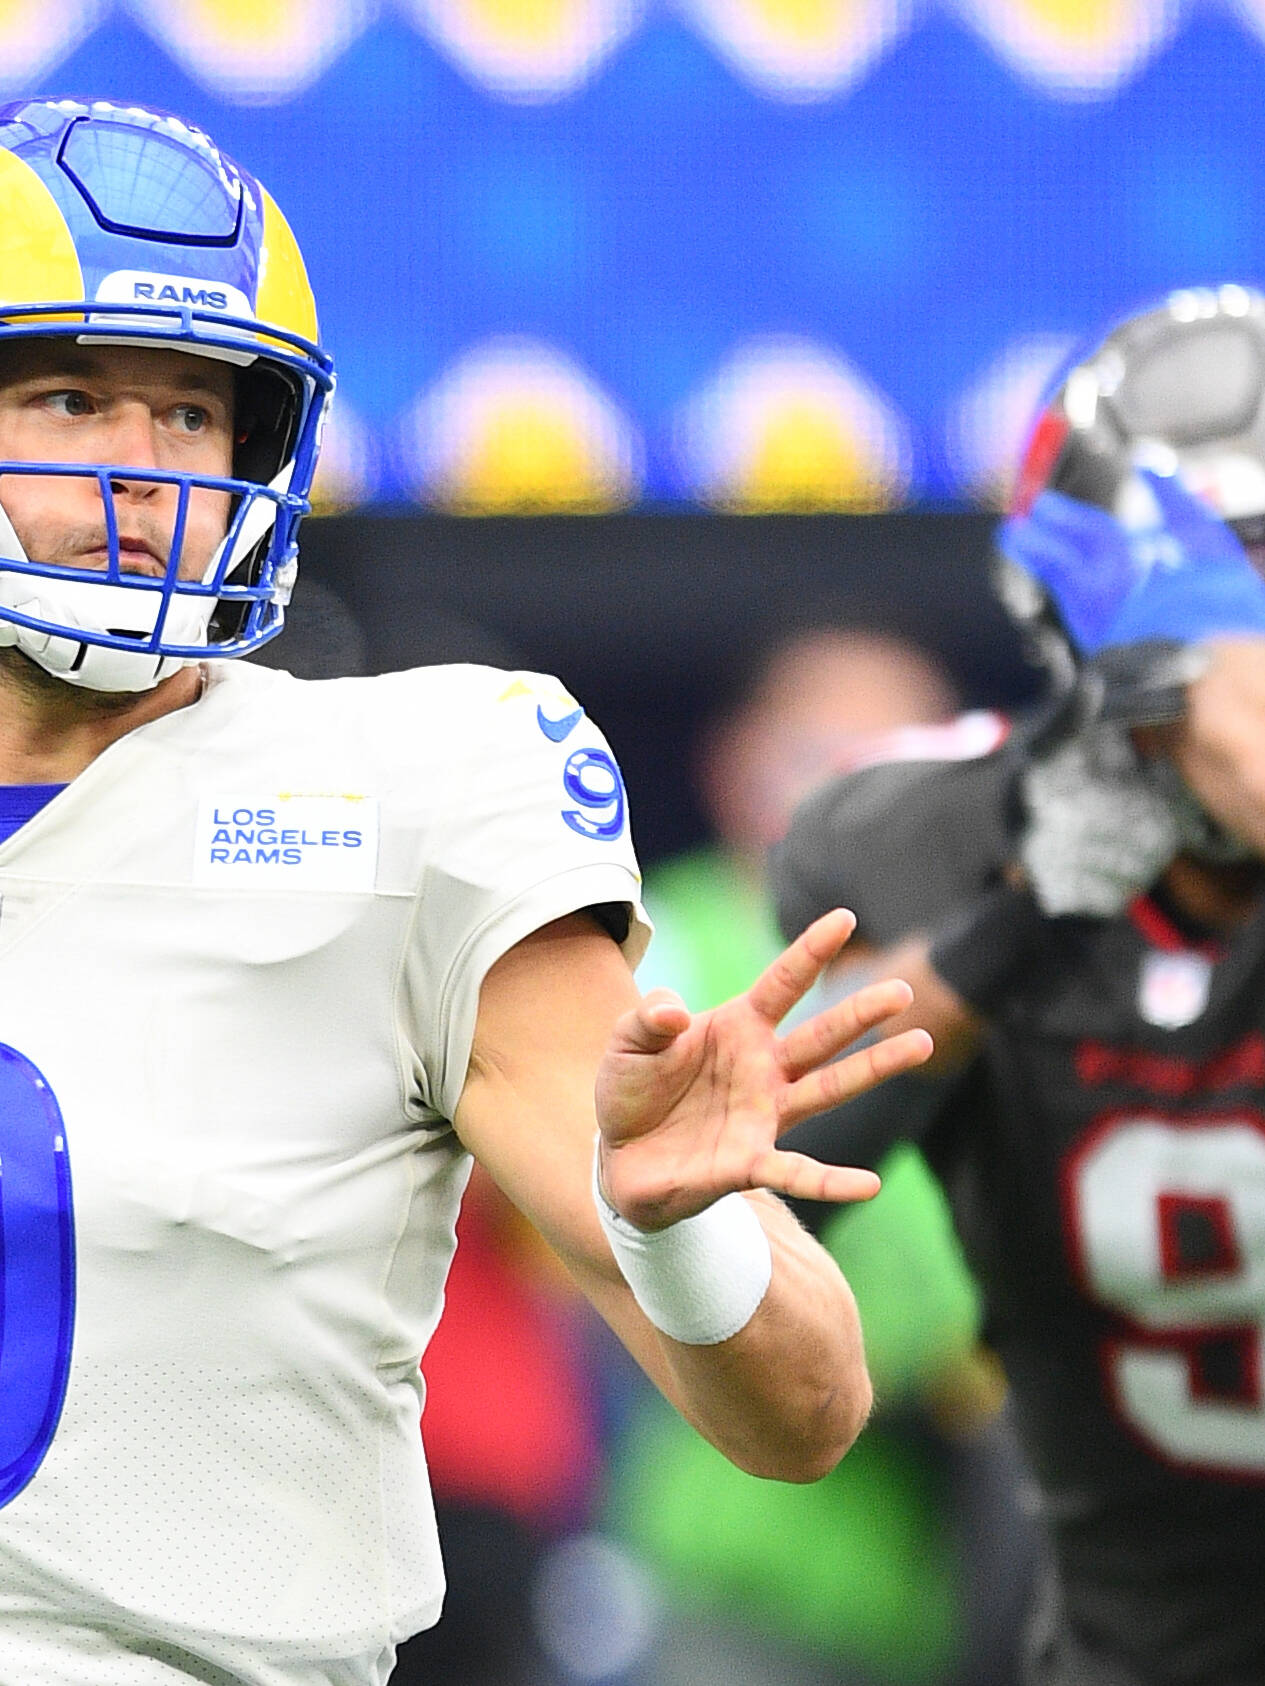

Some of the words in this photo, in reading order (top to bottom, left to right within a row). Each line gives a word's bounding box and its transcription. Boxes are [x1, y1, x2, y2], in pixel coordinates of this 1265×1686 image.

[134, 283, 228, 309] RAMS
[561, 748, 627, 842] 9
[213, 809, 275, 826] LOS
[211, 828, 362, 849] ANGELES
[210, 849, 302, 865] RAMS
